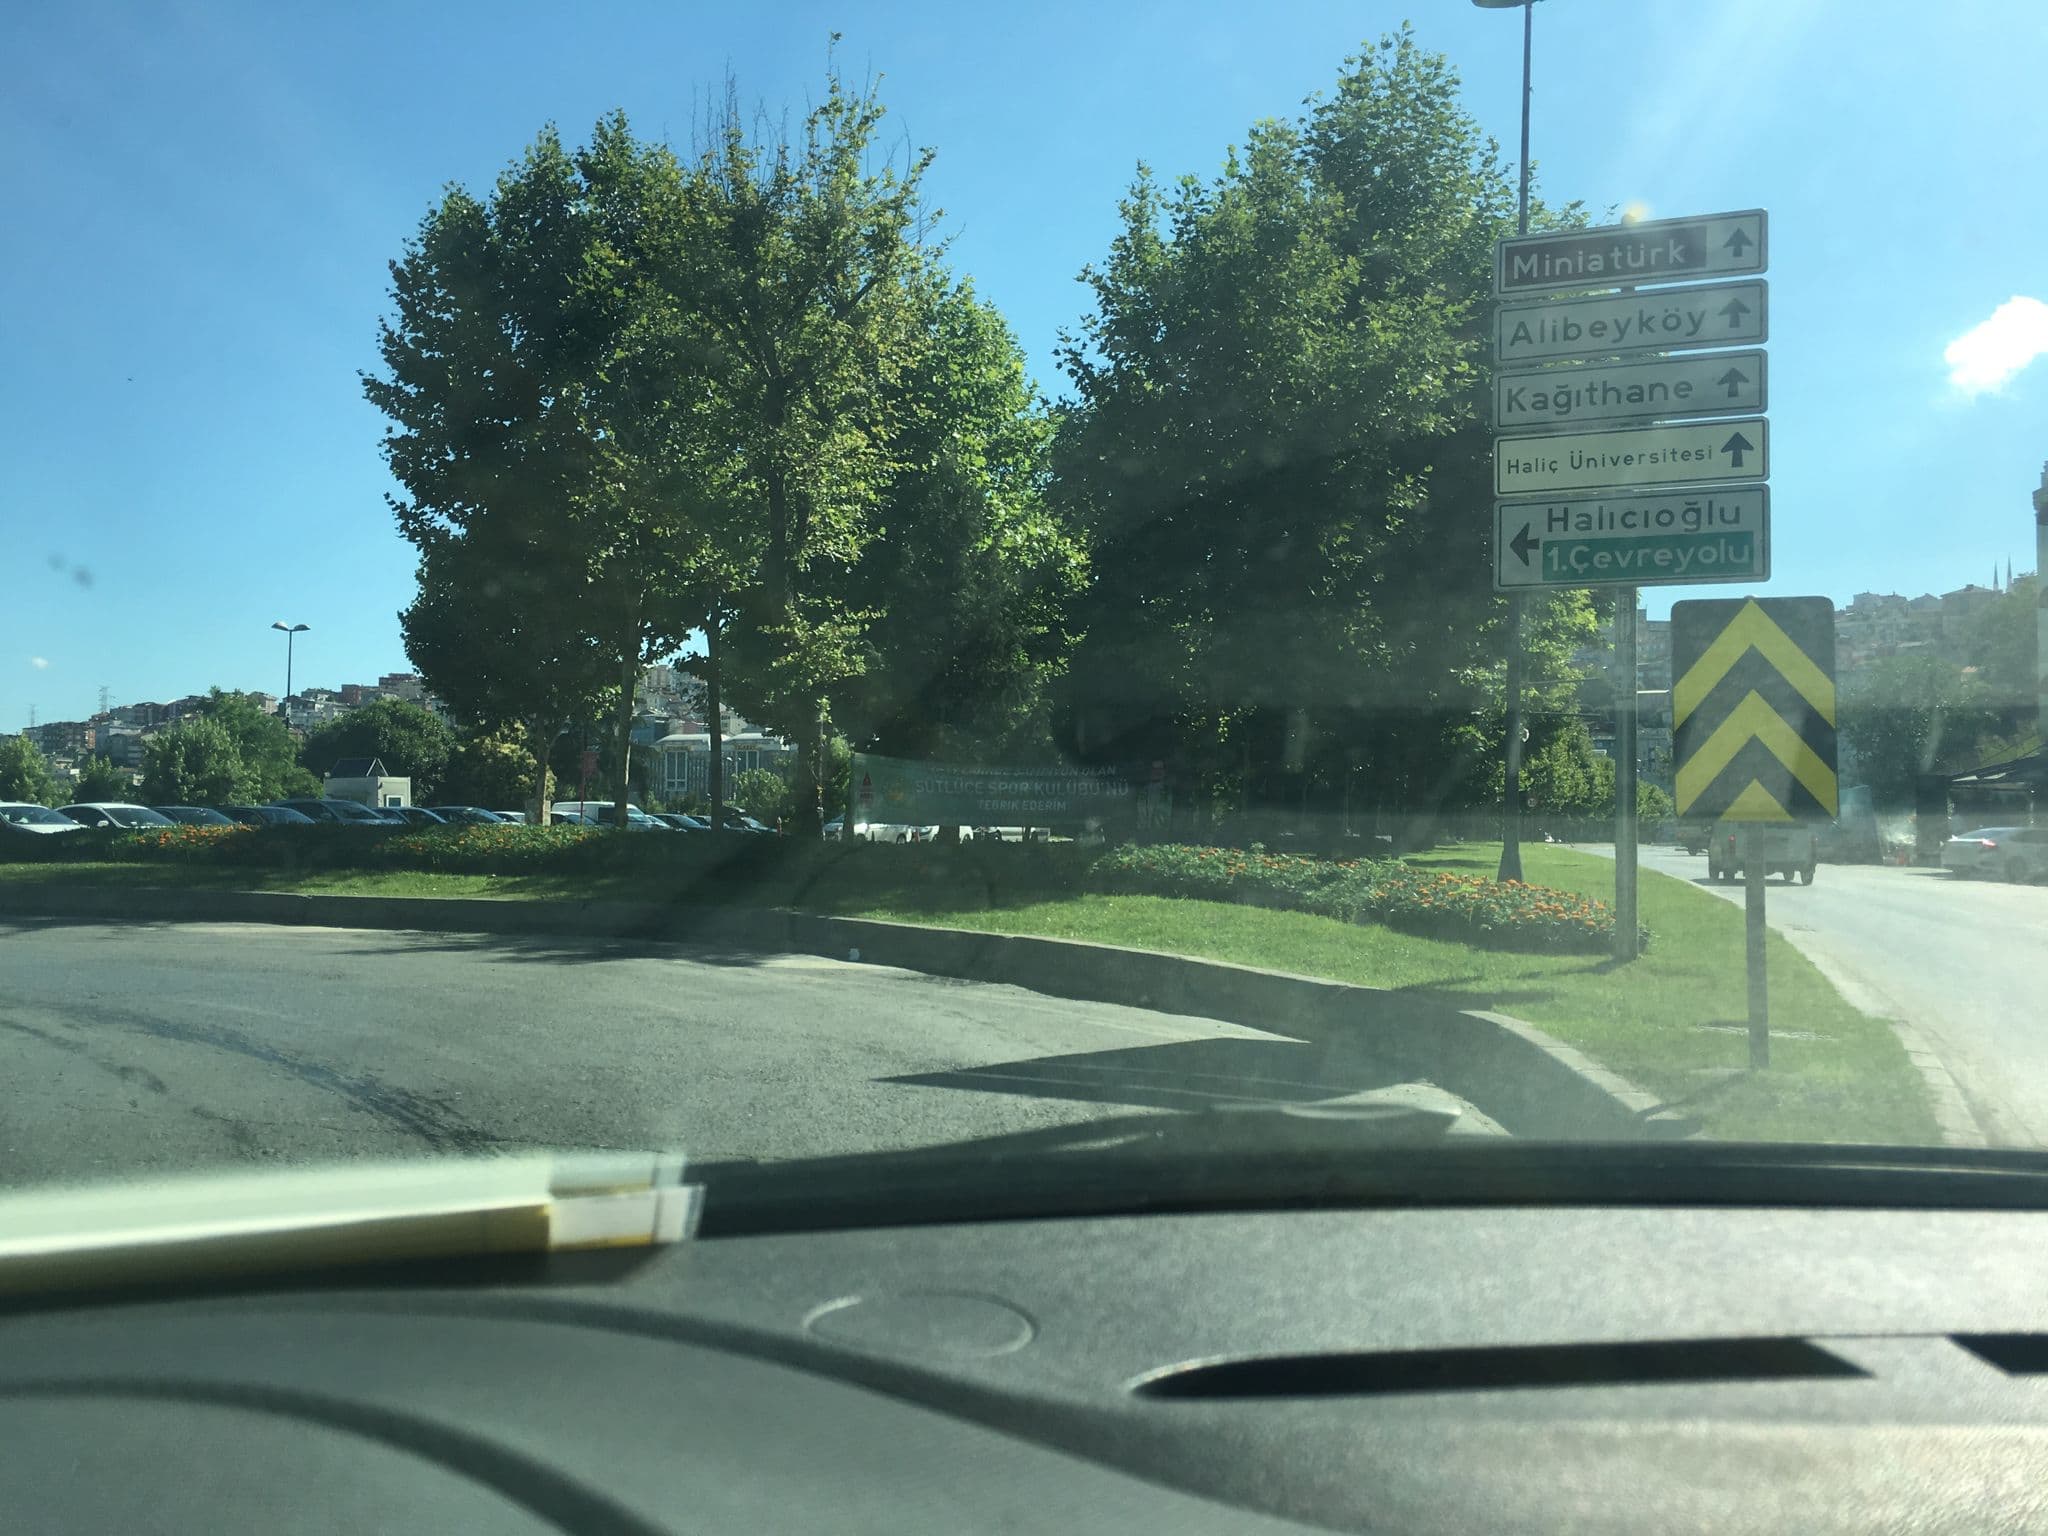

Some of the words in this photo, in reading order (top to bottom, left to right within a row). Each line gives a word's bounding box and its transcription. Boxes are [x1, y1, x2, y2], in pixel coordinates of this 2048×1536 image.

[1512, 239, 1686, 279] Miniatürk
[1509, 306, 1707, 346] Alibeyköy
[1507, 377, 1694, 414] Kağıthane
[1507, 457, 1559, 474] Haliç
[1569, 445, 1713, 471] Üniversitesi
[1547, 500, 1742, 532] Halıcıoğlu
[1548, 538, 1752, 575] 1.Çevreyolu
[988, 781, 1030, 795] SPOR
